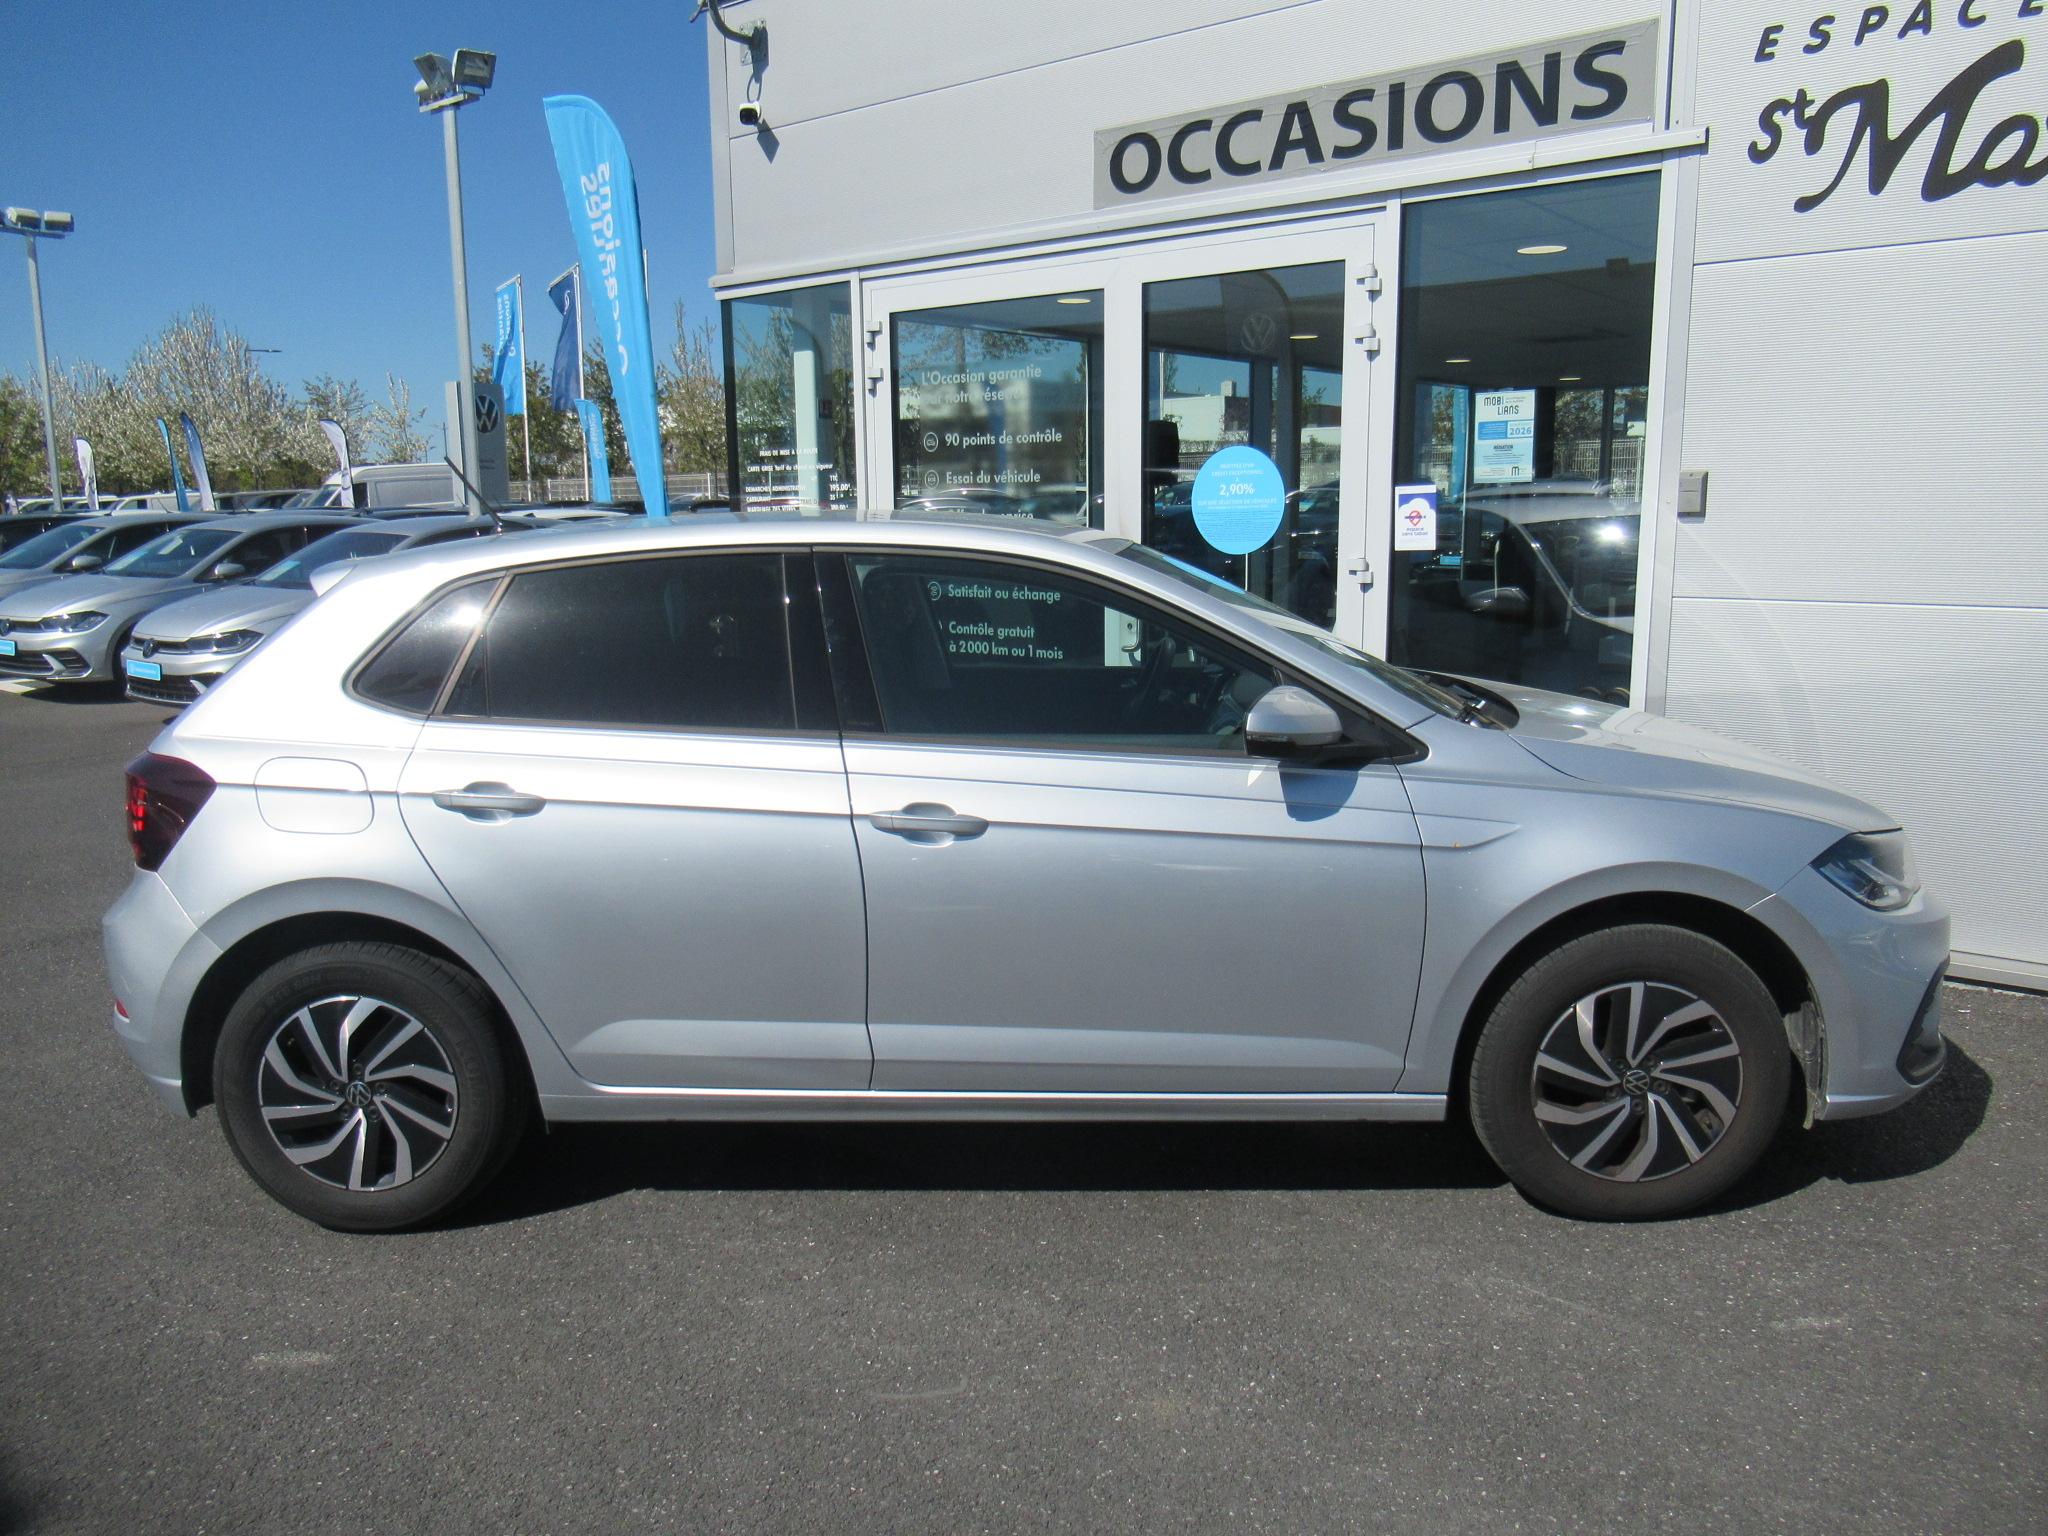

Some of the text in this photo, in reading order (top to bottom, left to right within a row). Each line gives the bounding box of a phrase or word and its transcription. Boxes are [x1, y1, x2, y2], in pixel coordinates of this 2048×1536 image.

[1109, 39, 1628, 195] OCCASIONS
[1793, 39, 2048, 213] Ma
[922, 364, 1042, 386] L'Occasion garantie
[945, 428, 1062, 448] 90 points de contrôle
[1509, 427, 1532, 436] 2026
[946, 469, 1041, 486] Essai du véhicule
[948, 584, 1061, 604] Satisfait ou échange
[949, 621, 1035, 640] Contrôle gratuit
[950, 641, 957, 653] à
[992, 642, 1009, 656] km
[1012, 647, 1025, 657] ou
[1036, 646, 1063, 660] mois
